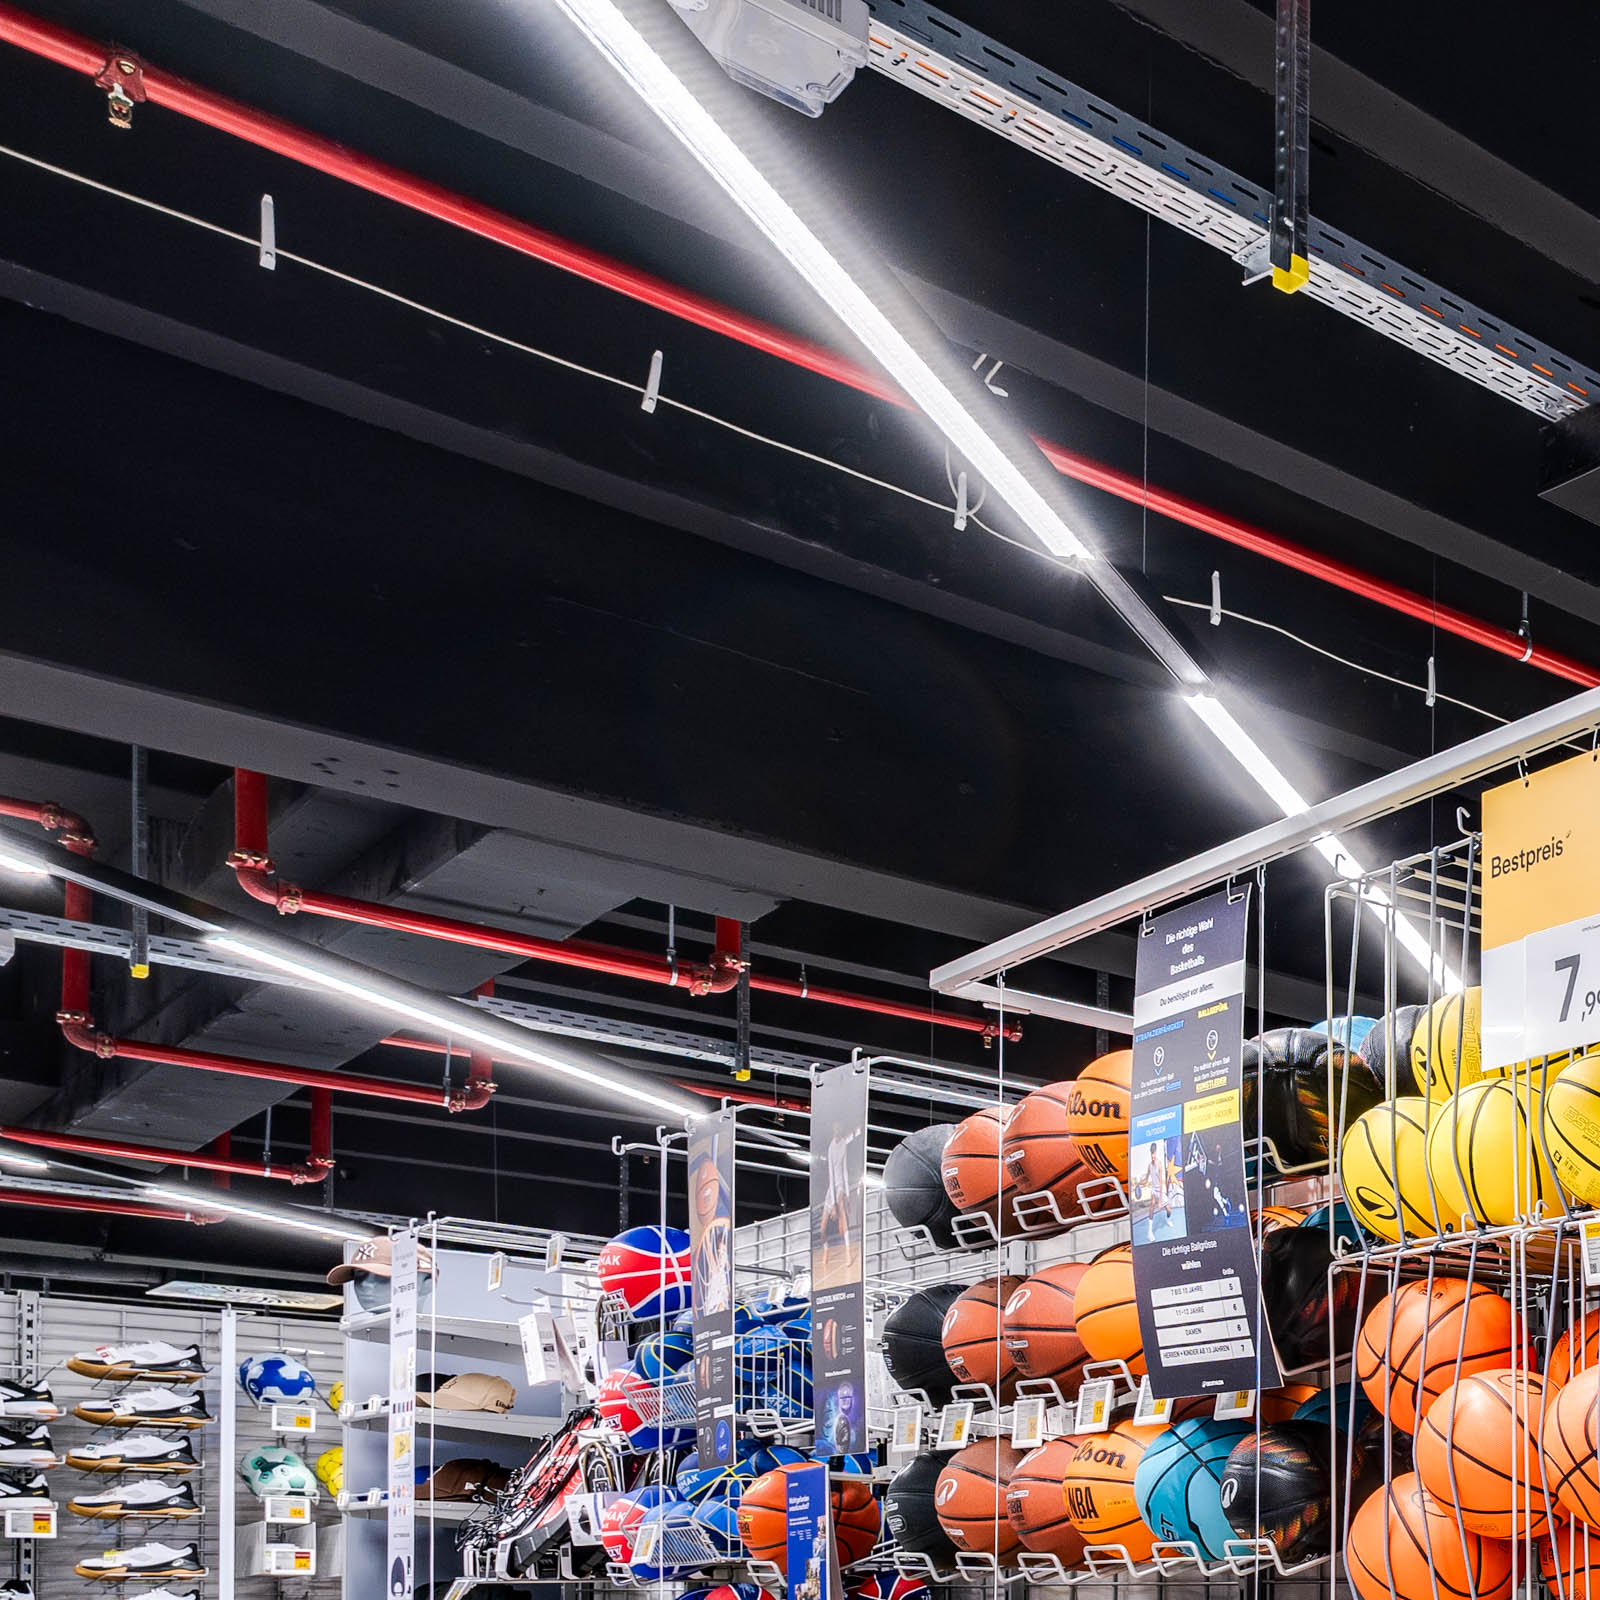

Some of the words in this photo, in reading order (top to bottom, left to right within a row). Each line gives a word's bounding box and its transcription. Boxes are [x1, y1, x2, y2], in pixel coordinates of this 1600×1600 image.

[1491, 836, 1564, 879] Bestpreis
[1069, 1090, 1122, 1119] ilson
[1072, 1440, 1126, 1469] ilson
[1067, 1486, 1099, 1520] NBA
